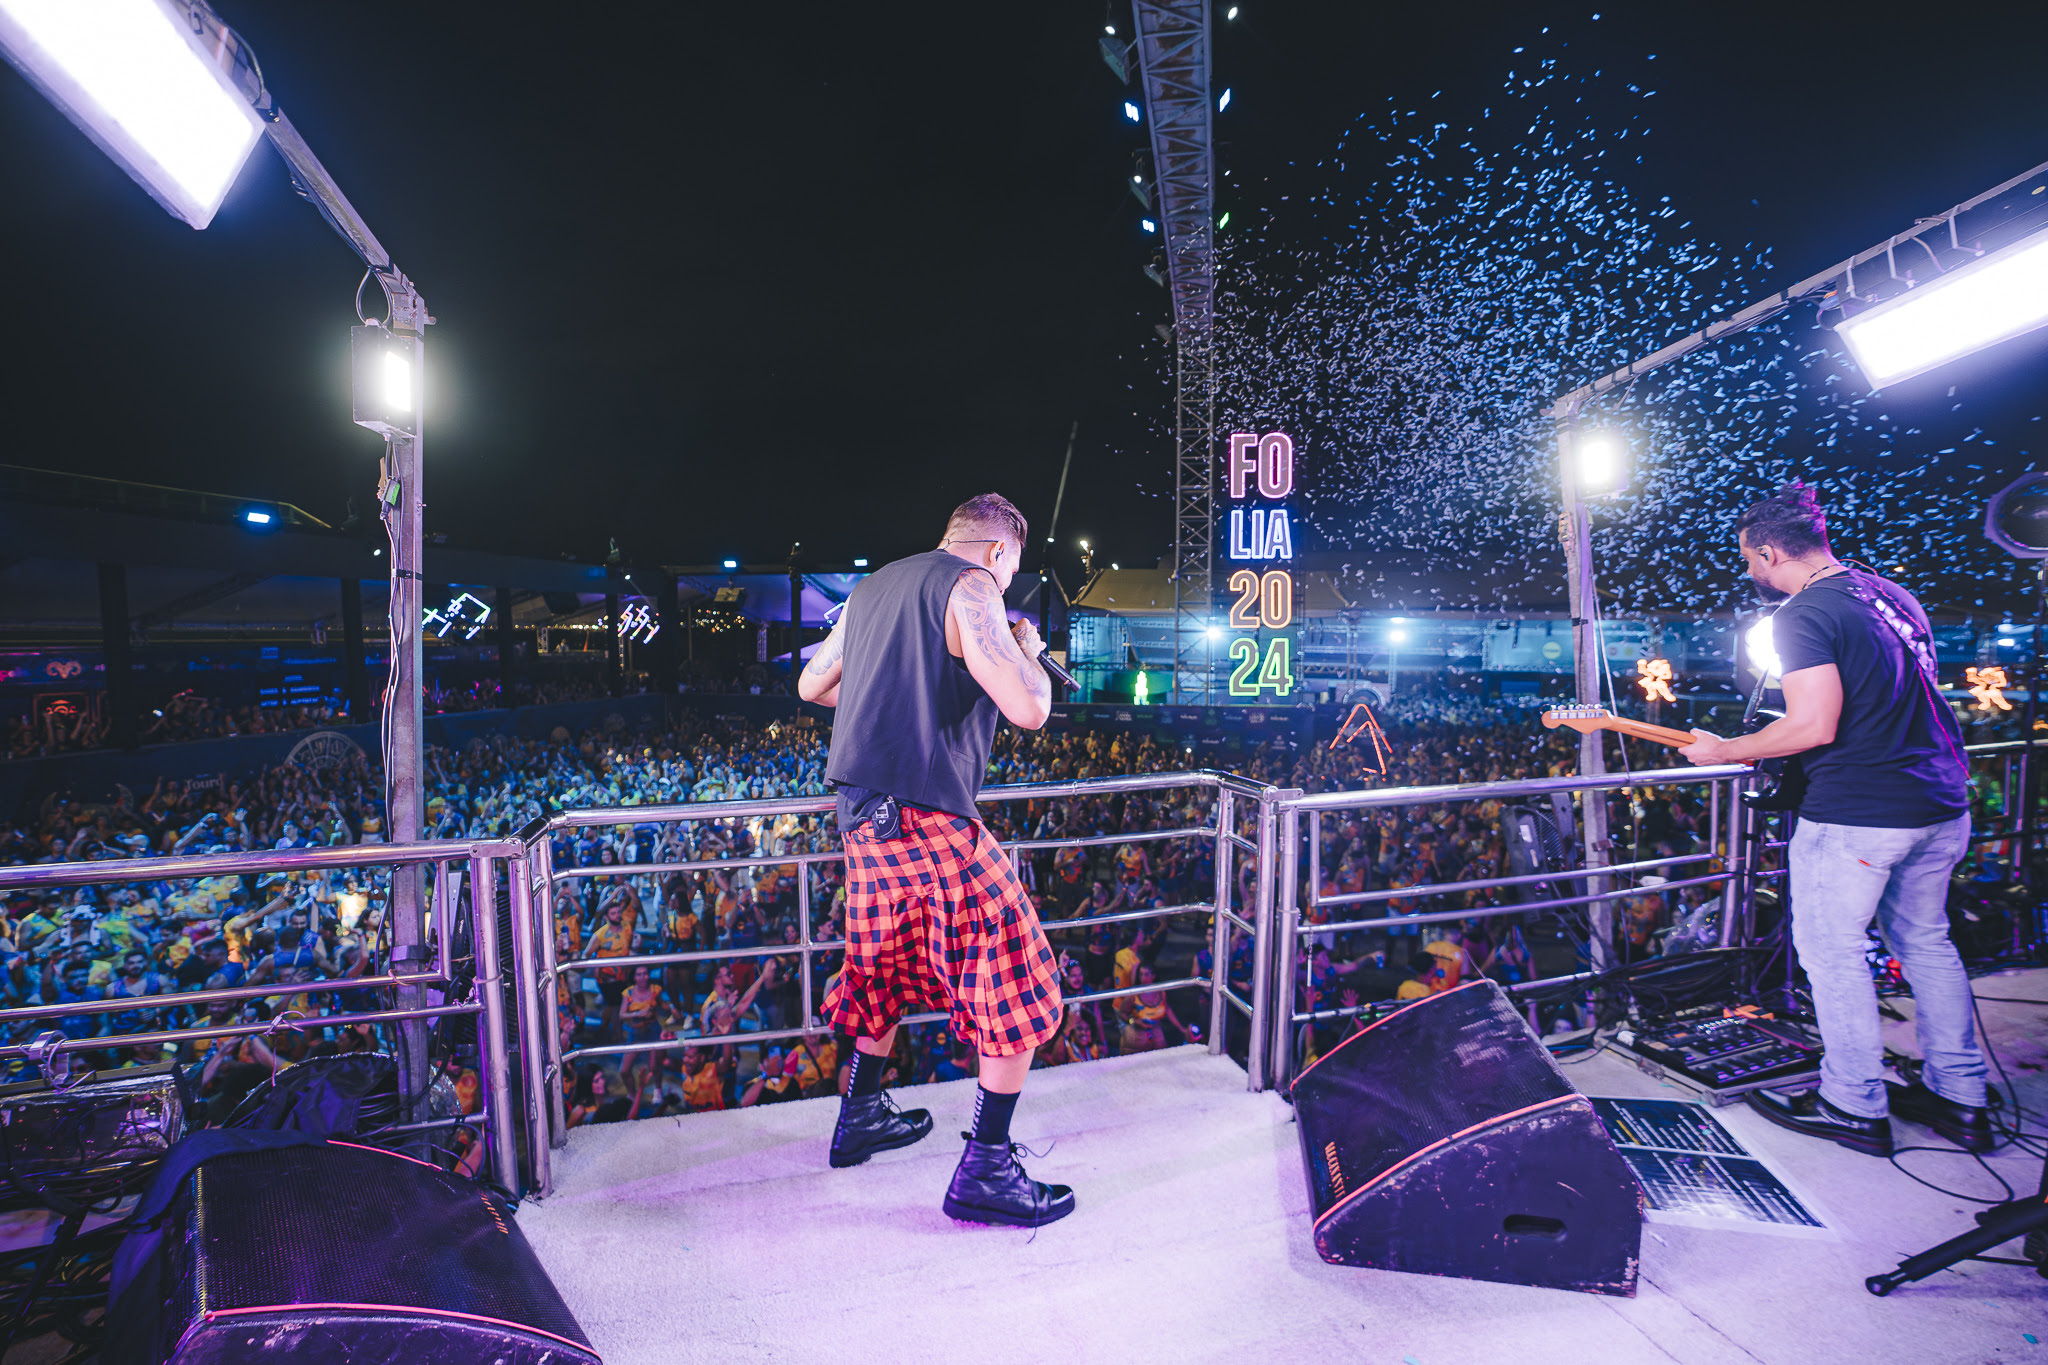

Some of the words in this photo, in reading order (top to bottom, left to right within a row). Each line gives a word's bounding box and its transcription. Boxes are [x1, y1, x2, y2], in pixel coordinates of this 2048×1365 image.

[1230, 432, 1293, 499] FO
[1230, 509, 1293, 559] LIA
[1229, 570, 1292, 629] 20
[1229, 637, 1294, 697] 24
